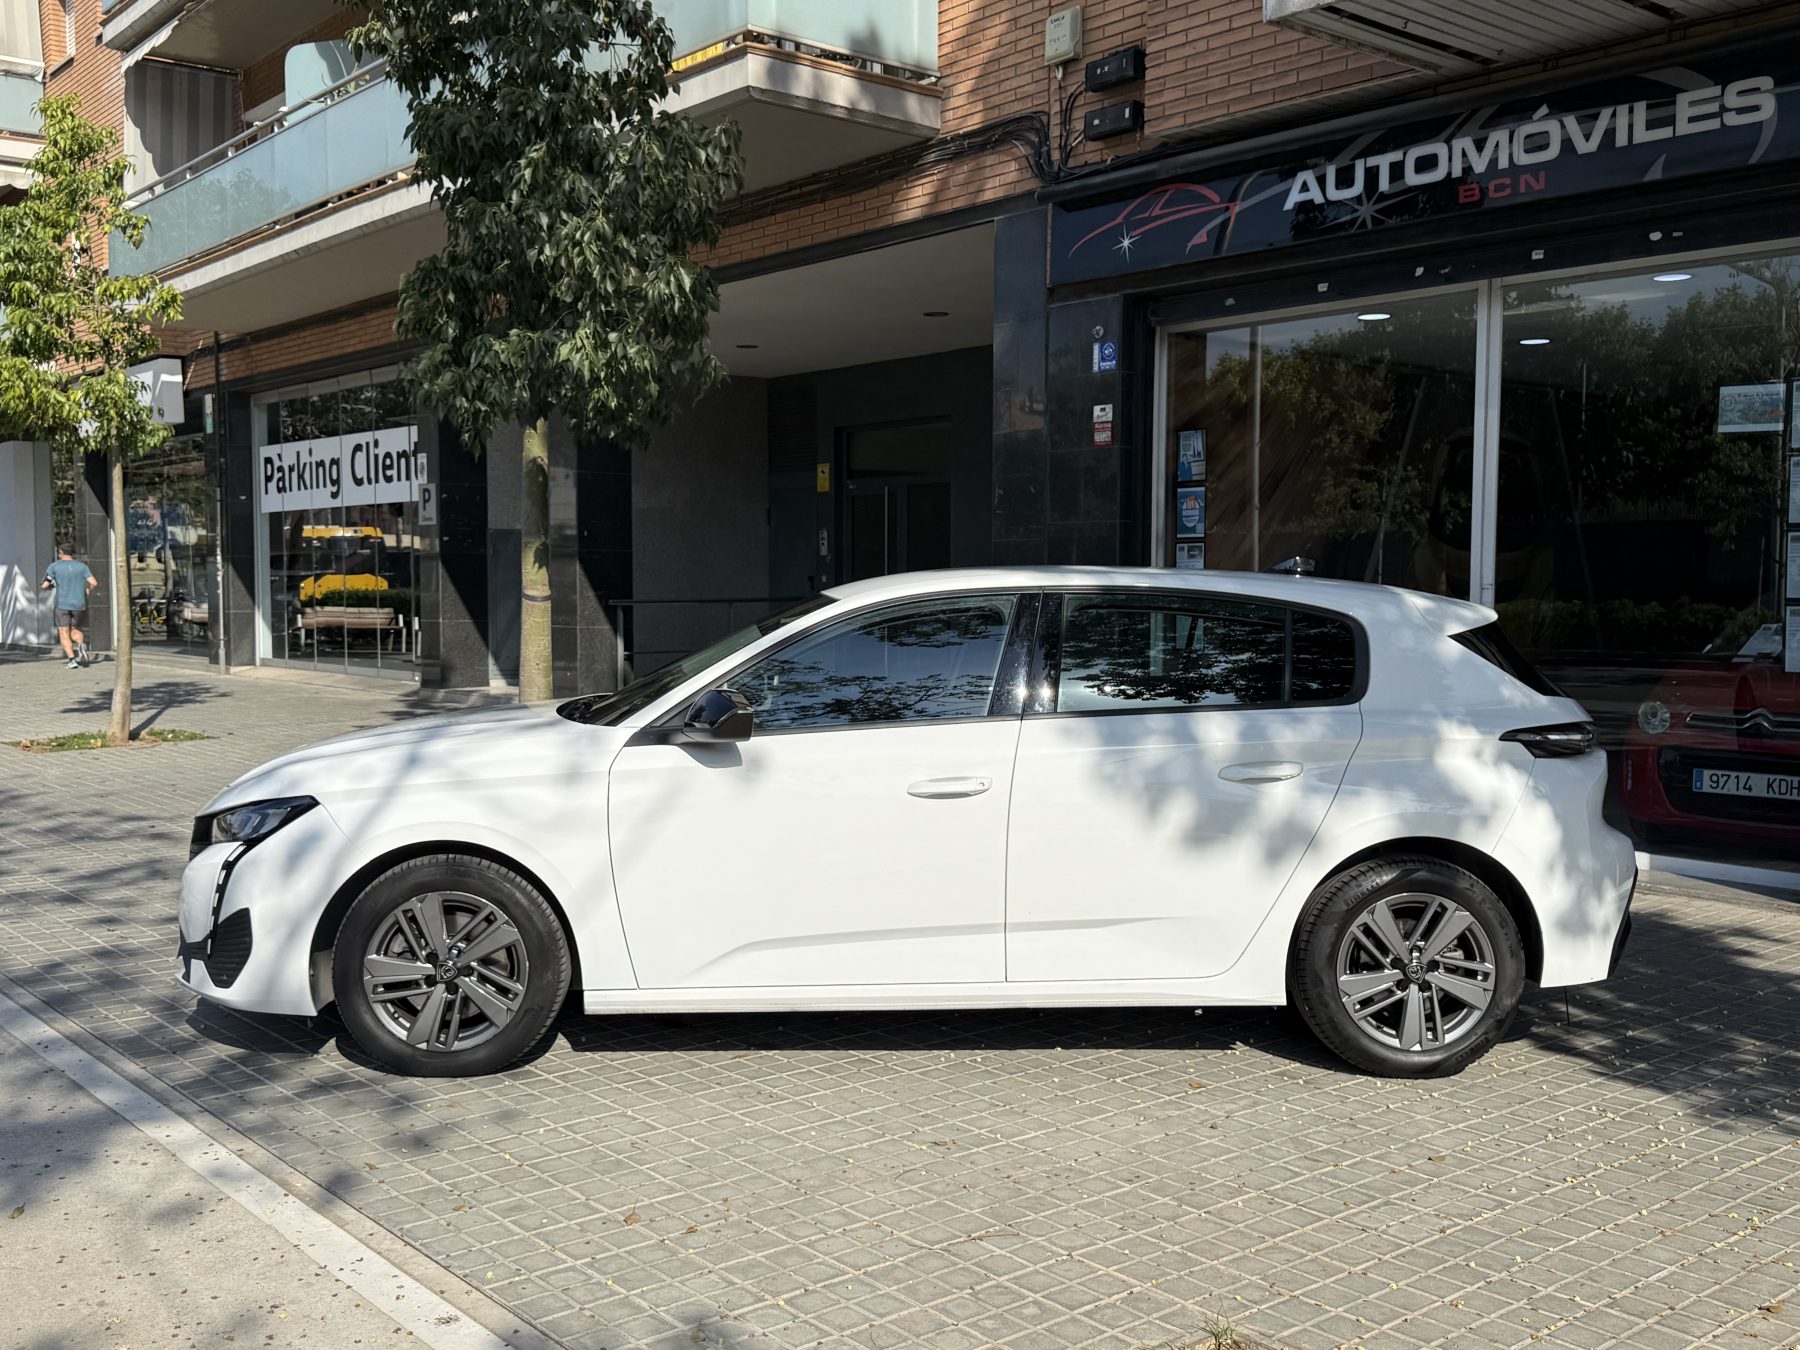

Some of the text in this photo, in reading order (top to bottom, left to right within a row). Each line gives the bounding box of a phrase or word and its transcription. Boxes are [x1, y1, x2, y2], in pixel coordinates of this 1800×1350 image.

[1283, 75, 1775, 212] AUTOMÓVILES
[1457, 170, 1547, 205] BCN
[263, 448, 341, 500] Pàrking
[422, 488, 431, 512] P
[1709, 773, 1800, 797] 9714 KDH
